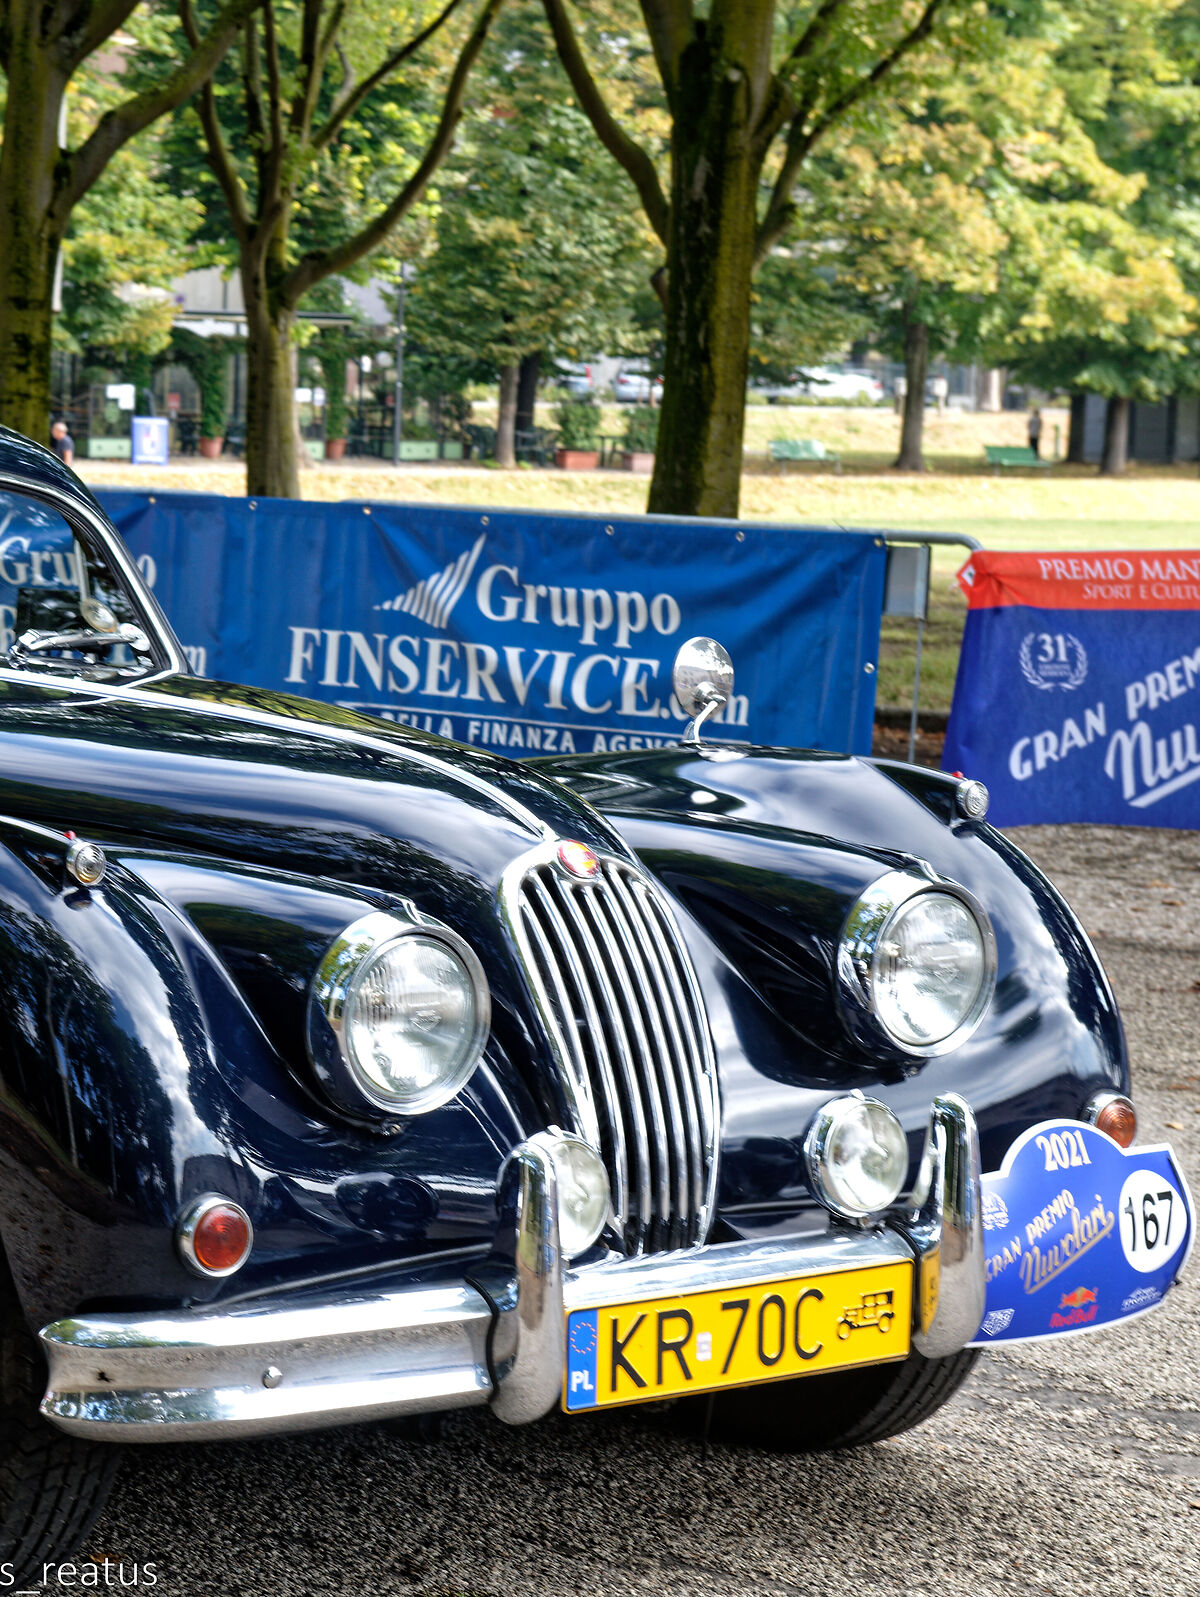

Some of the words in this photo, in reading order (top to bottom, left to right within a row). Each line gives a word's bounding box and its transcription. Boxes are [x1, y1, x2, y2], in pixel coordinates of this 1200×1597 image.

[1037, 557, 1134, 580] PREMIO
[1140, 583, 1149, 599] E
[476, 564, 681, 648] Gruppo
[285, 625, 749, 726] FINSERVICE.cm
[1036, 633, 1069, 663] 31
[467, 720, 577, 754] FINANZA
[1008, 701, 1107, 781] GRAN
[1036, 1129, 1092, 1172] 2021
[1018, 1193, 1115, 1294] Nuvolari
[1024, 1188, 1075, 1247] PREMIO
[1124, 1190, 1174, 1253] 167
[611, 1308, 693, 1393] KR
[720, 1287, 825, 1375] 70C
[570, 1369, 595, 1394] PL
